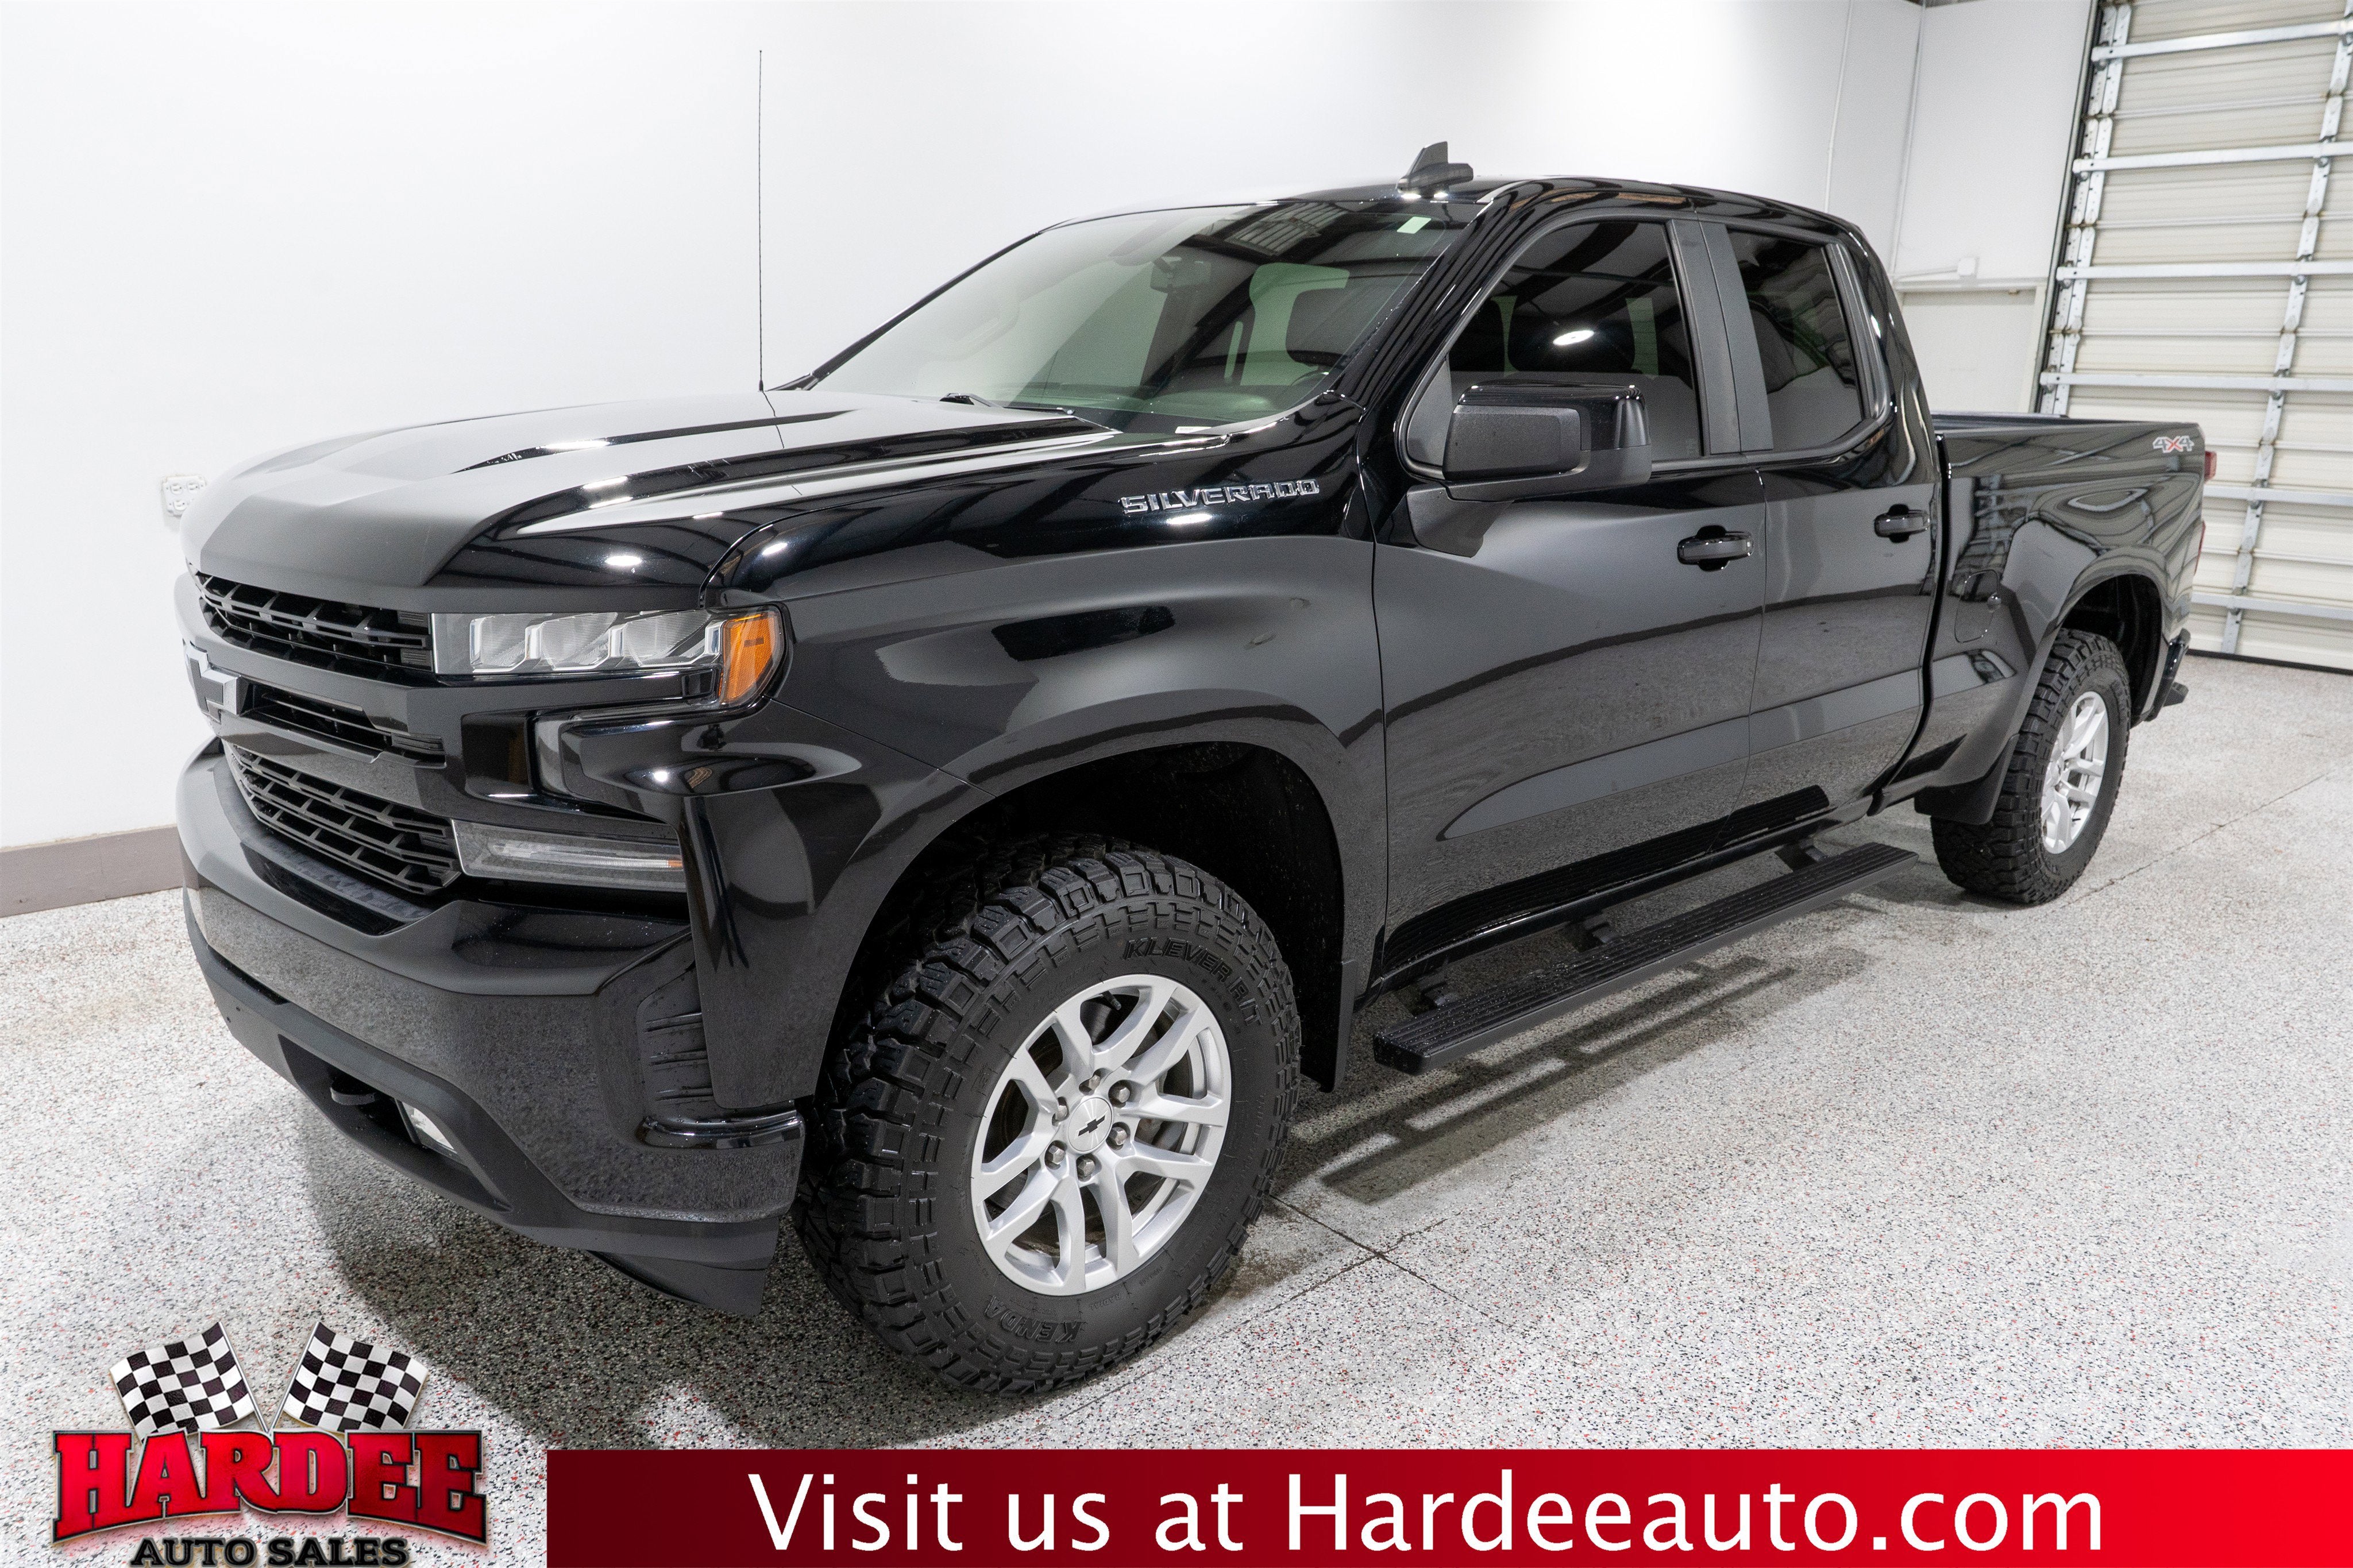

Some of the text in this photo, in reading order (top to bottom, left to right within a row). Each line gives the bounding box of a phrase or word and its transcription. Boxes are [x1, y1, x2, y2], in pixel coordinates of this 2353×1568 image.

[1119, 478, 1320, 514] SILVERADO
[1123, 937, 1233, 983] KLEVER
[1227, 976, 1263, 1026] R/T
[984, 1296, 1082, 1343] KENDA
